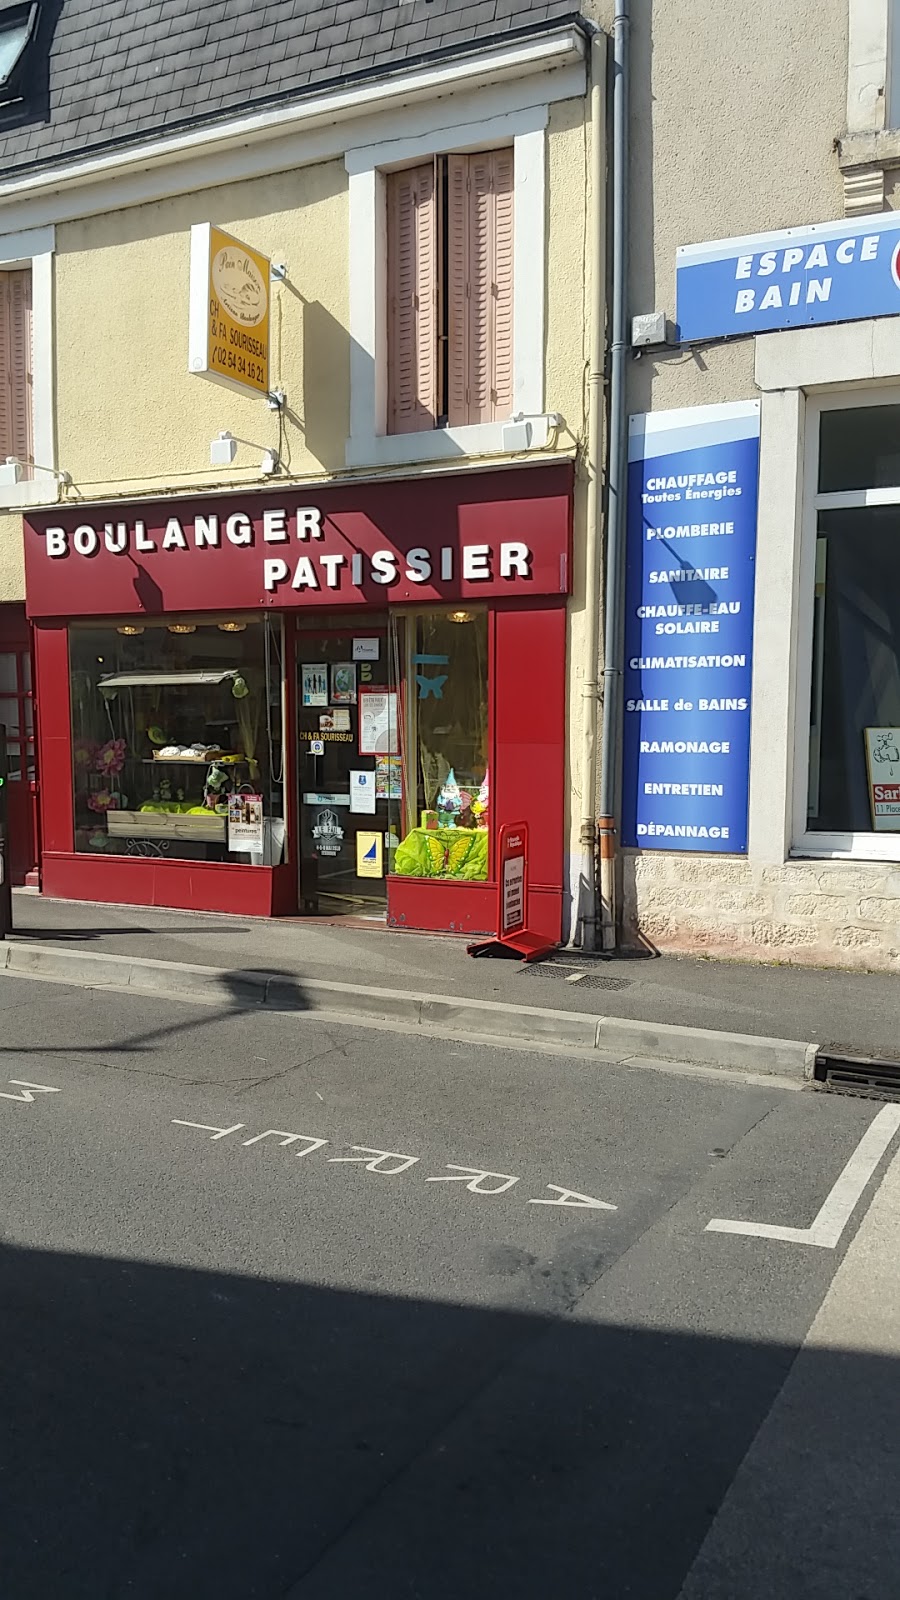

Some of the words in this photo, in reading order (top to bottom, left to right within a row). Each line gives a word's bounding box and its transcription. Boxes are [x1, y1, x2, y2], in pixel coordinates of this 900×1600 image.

[735, 235, 880, 280] ESPACE
[735, 277, 832, 313] BAIN
[210, 299, 219, 318] CH
[211, 319, 218, 337] &
[219, 322, 227, 341] FA
[230, 328, 267, 360] SOURISSEAU
[218, 346, 227, 365] 02
[228, 350, 236, 370] 54
[238, 355, 246, 374] 34
[248, 361, 256, 379] 16
[256, 365, 265, 384] 21
[646, 470, 737, 491] CHAUFFAGE
[641, 492, 681, 504] Toutes
[685, 485, 742, 501] Énergies
[46, 507, 321, 556] BOULANGER
[646, 522, 734, 541] PLOMBERIE
[264, 542, 531, 590] PATISSIER
[649, 567, 729, 584] SANITAIRE
[637, 601, 740, 618] CHAUFFE-EAU
[655, 620, 719, 635] SOLAIRE
[630, 654, 746, 670] CLIMATISATION
[627, 699, 669, 712] SALLE
[674, 699, 693, 711] de
[699, 698, 748, 711] BAINS
[300, 731, 308, 741] CH
[308, 732, 313, 741] &
[313, 732, 320, 741] FA
[320, 732, 353, 742] SOURISSEAU
[640, 741, 730, 754] RAMONAGE
[644, 783, 723, 797] ENTRETIEN
[637, 821, 730, 839] DÉPANNAGE
[171, 1119, 618, 1211] ARRET
